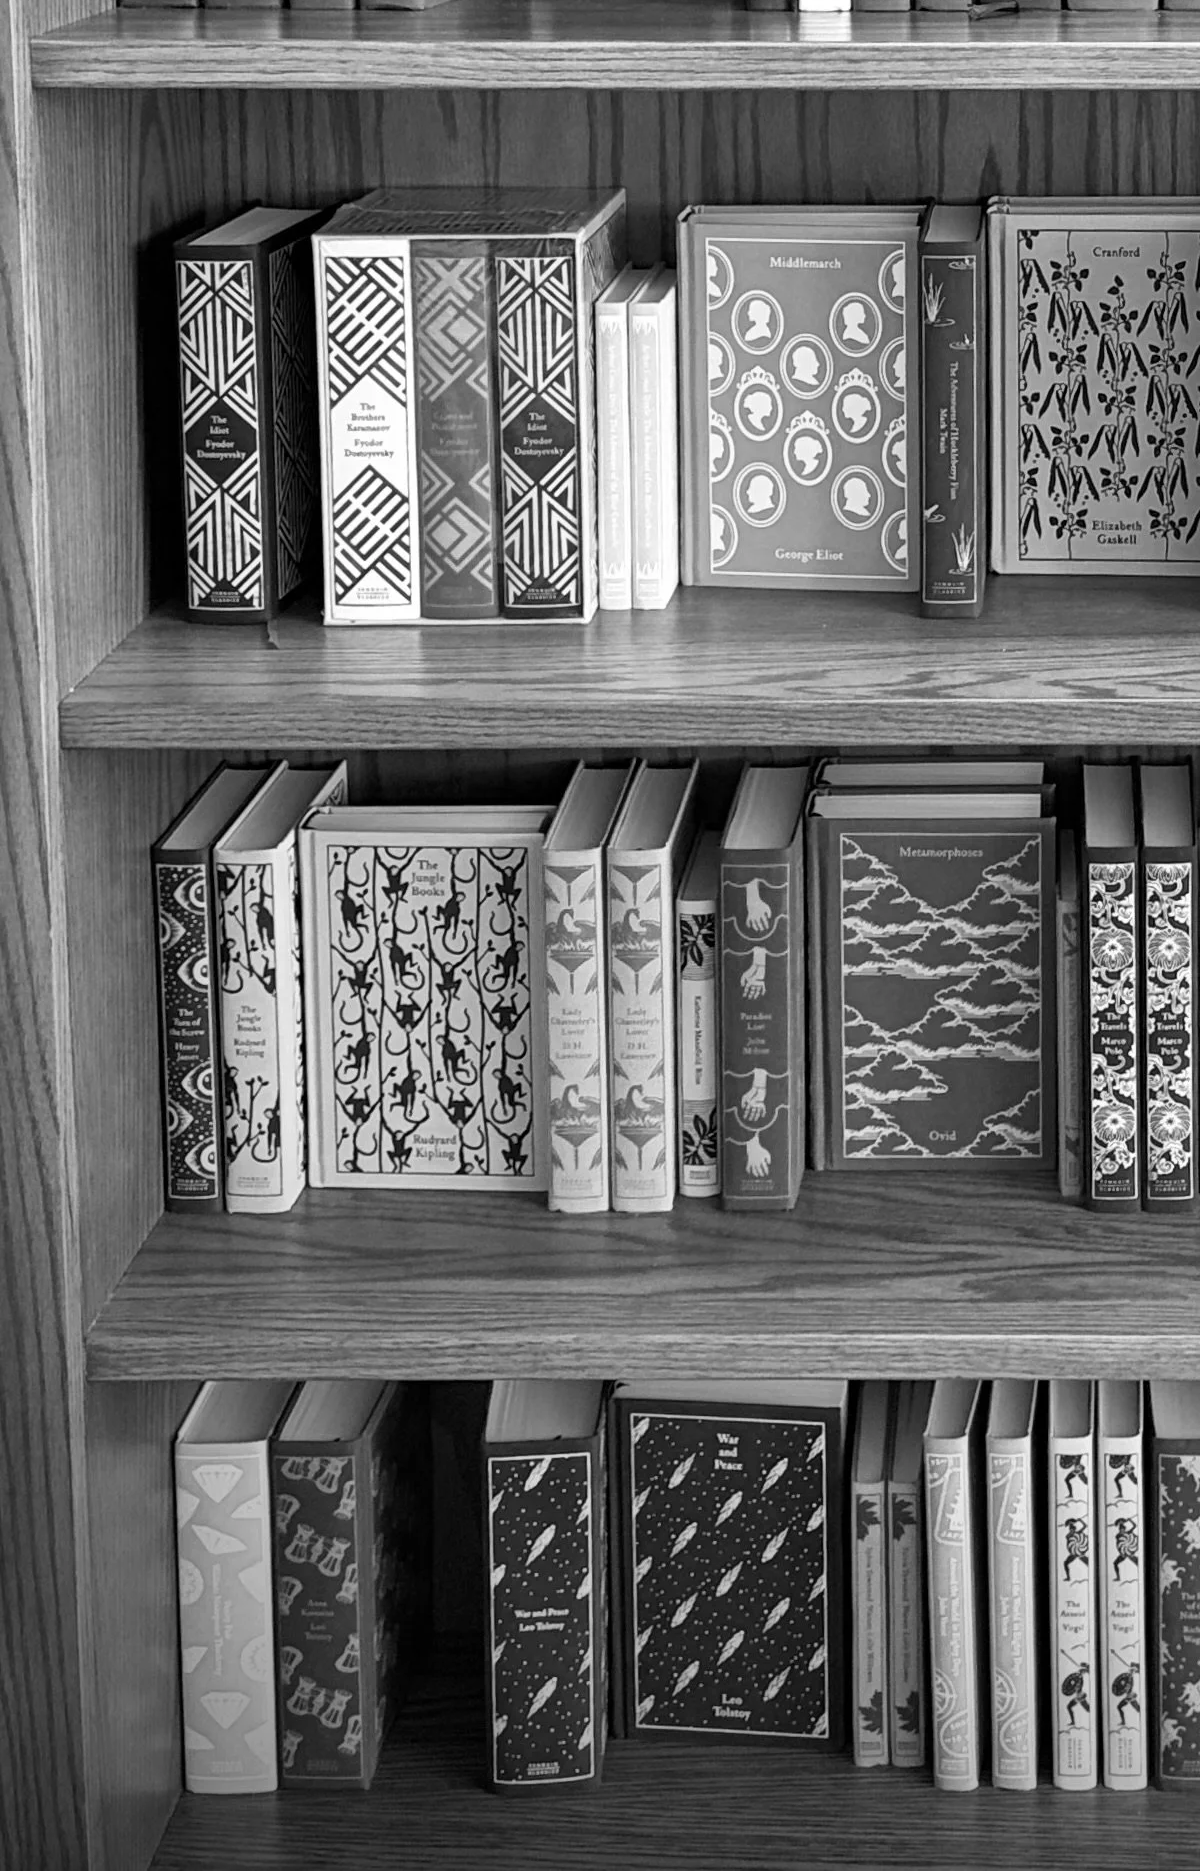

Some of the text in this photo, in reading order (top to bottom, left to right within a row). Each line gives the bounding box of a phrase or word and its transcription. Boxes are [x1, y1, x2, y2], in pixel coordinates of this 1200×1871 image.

[1093, 246, 1141, 258] Cranford
[769, 255, 841, 269] Middlemarch
[360, 403, 376, 412] The
[212, 415, 227, 424] The
[351, 413, 385, 422] Brothers
[530, 412, 545, 421] The
[210, 426, 230, 435] Idiot
[347, 424, 391, 432] Karamazov
[528, 423, 547, 432] Idiot
[206, 440, 235, 450] Fyodor
[354, 439, 383, 449] Fyodor
[523, 437, 552, 447] Fyodor
[197, 447, 246, 460] Dostoyevsky
[344, 449, 394, 461] Dostoyevsky
[514, 447, 564, 458] Dostoyevsky
[1092, 519, 1142, 531] Elizabeth
[1097, 533, 1137, 545] Gaskell
[774, 547, 843, 563] George Eliot
[899, 845, 984, 860] Metamorphoses
[417, 859, 440, 871] The
[410, 872, 446, 886] Jungle
[411, 887, 446, 898] Books
[413, 1133, 457, 1147] Rudyard
[929, 1130, 958, 1142] Ovid
[415, 1147, 456, 1162] Kipling
[717, 1432, 739, 1445] War
[719, 1447, 738, 1457] and
[714, 1459, 743, 1470] Peace
[514, 1608, 569, 1618] War and Peace
[519, 1621, 565, 1632] Leo Tolstoy
[722, 1693, 743, 1705] Leo
[712, 1706, 752, 1722] Tolstoy
